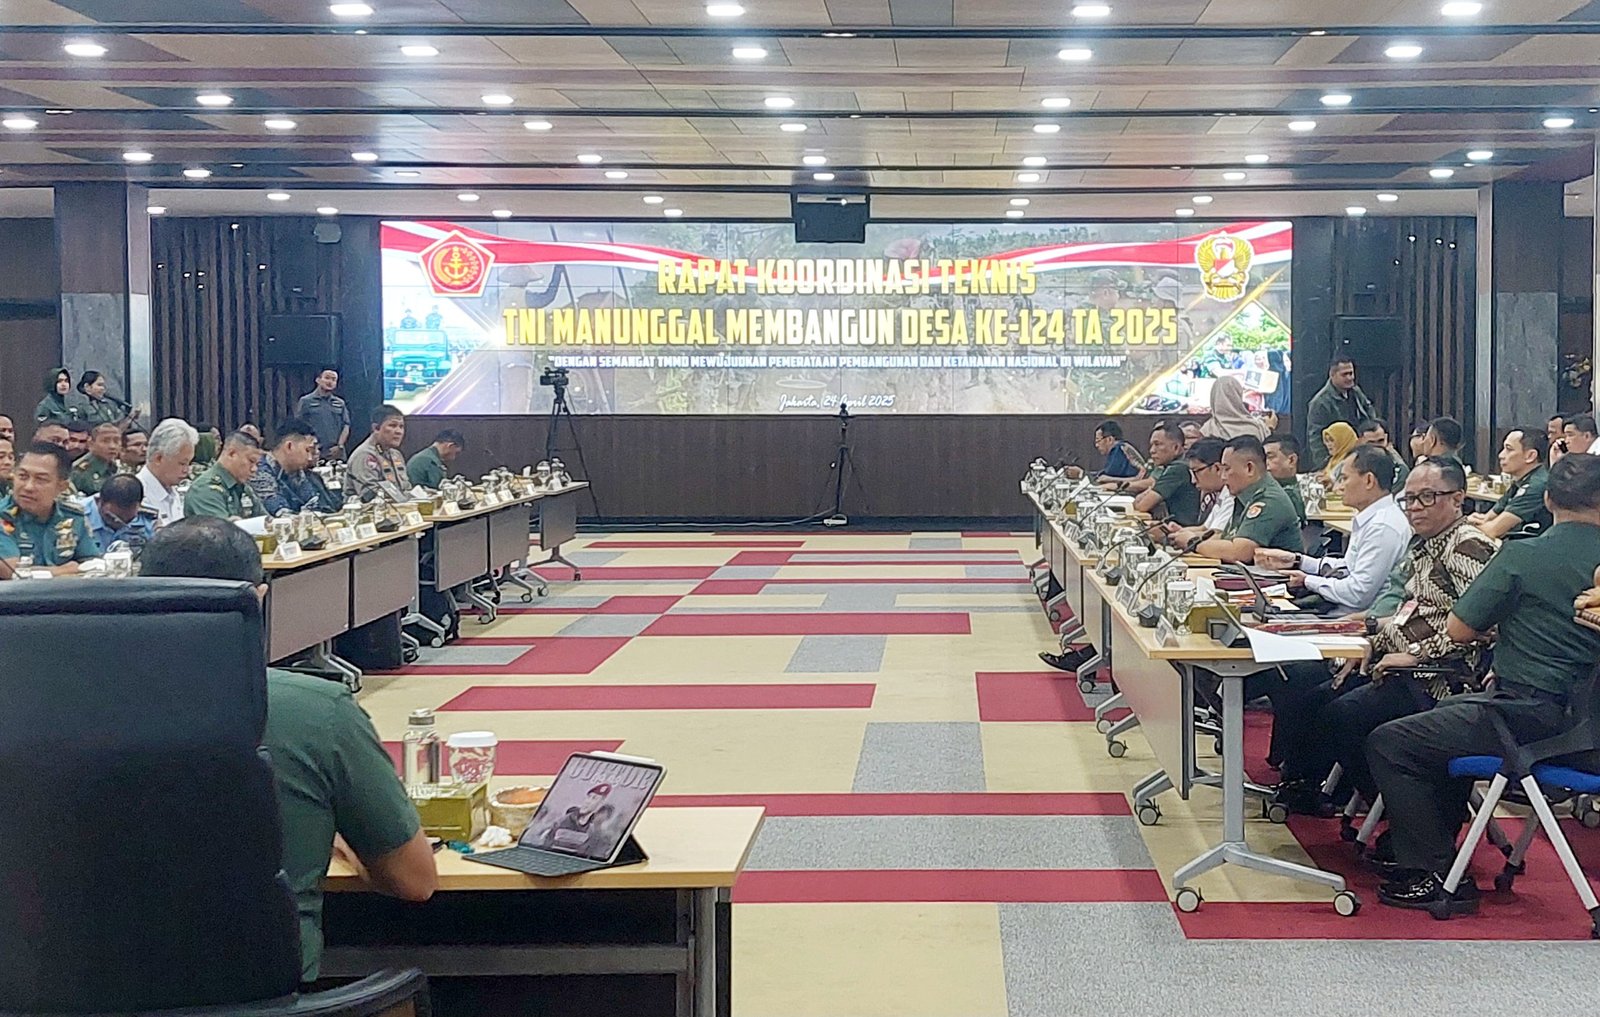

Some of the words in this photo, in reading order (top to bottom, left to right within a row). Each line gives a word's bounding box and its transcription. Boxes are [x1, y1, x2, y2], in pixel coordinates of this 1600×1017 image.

[657, 258, 750, 295] RAPAT
[756, 258, 931, 295] KOORDINASI
[938, 258, 1037, 296] TEKNIS
[503, 308, 546, 345] TNI
[552, 308, 720, 345] MANUNGGAL
[726, 308, 895, 345] MEMBANGUN
[901, 308, 969, 345] DESA
[975, 308, 1065, 345] KE-124
[1071, 308, 1104, 345] TA
[1109, 308, 1178, 345] 2025
[599, 355, 655, 369] SEMANGAT
[657, 355, 689, 369] TMMD
[690, 355, 767, 369] MEWUJUDKAN
[768, 355, 837, 369] PEMERATAAN
[838, 355, 919, 369] PEMBANGUNAN
[919, 355, 942, 369] DAN
[943, 355, 1006, 369] KETAHANAN
[1007, 355, 1059, 369] NASIONAL
[1060, 355, 1072, 369] DI
[823, 395, 838, 407] 24
[868, 394, 896, 407] 2025
